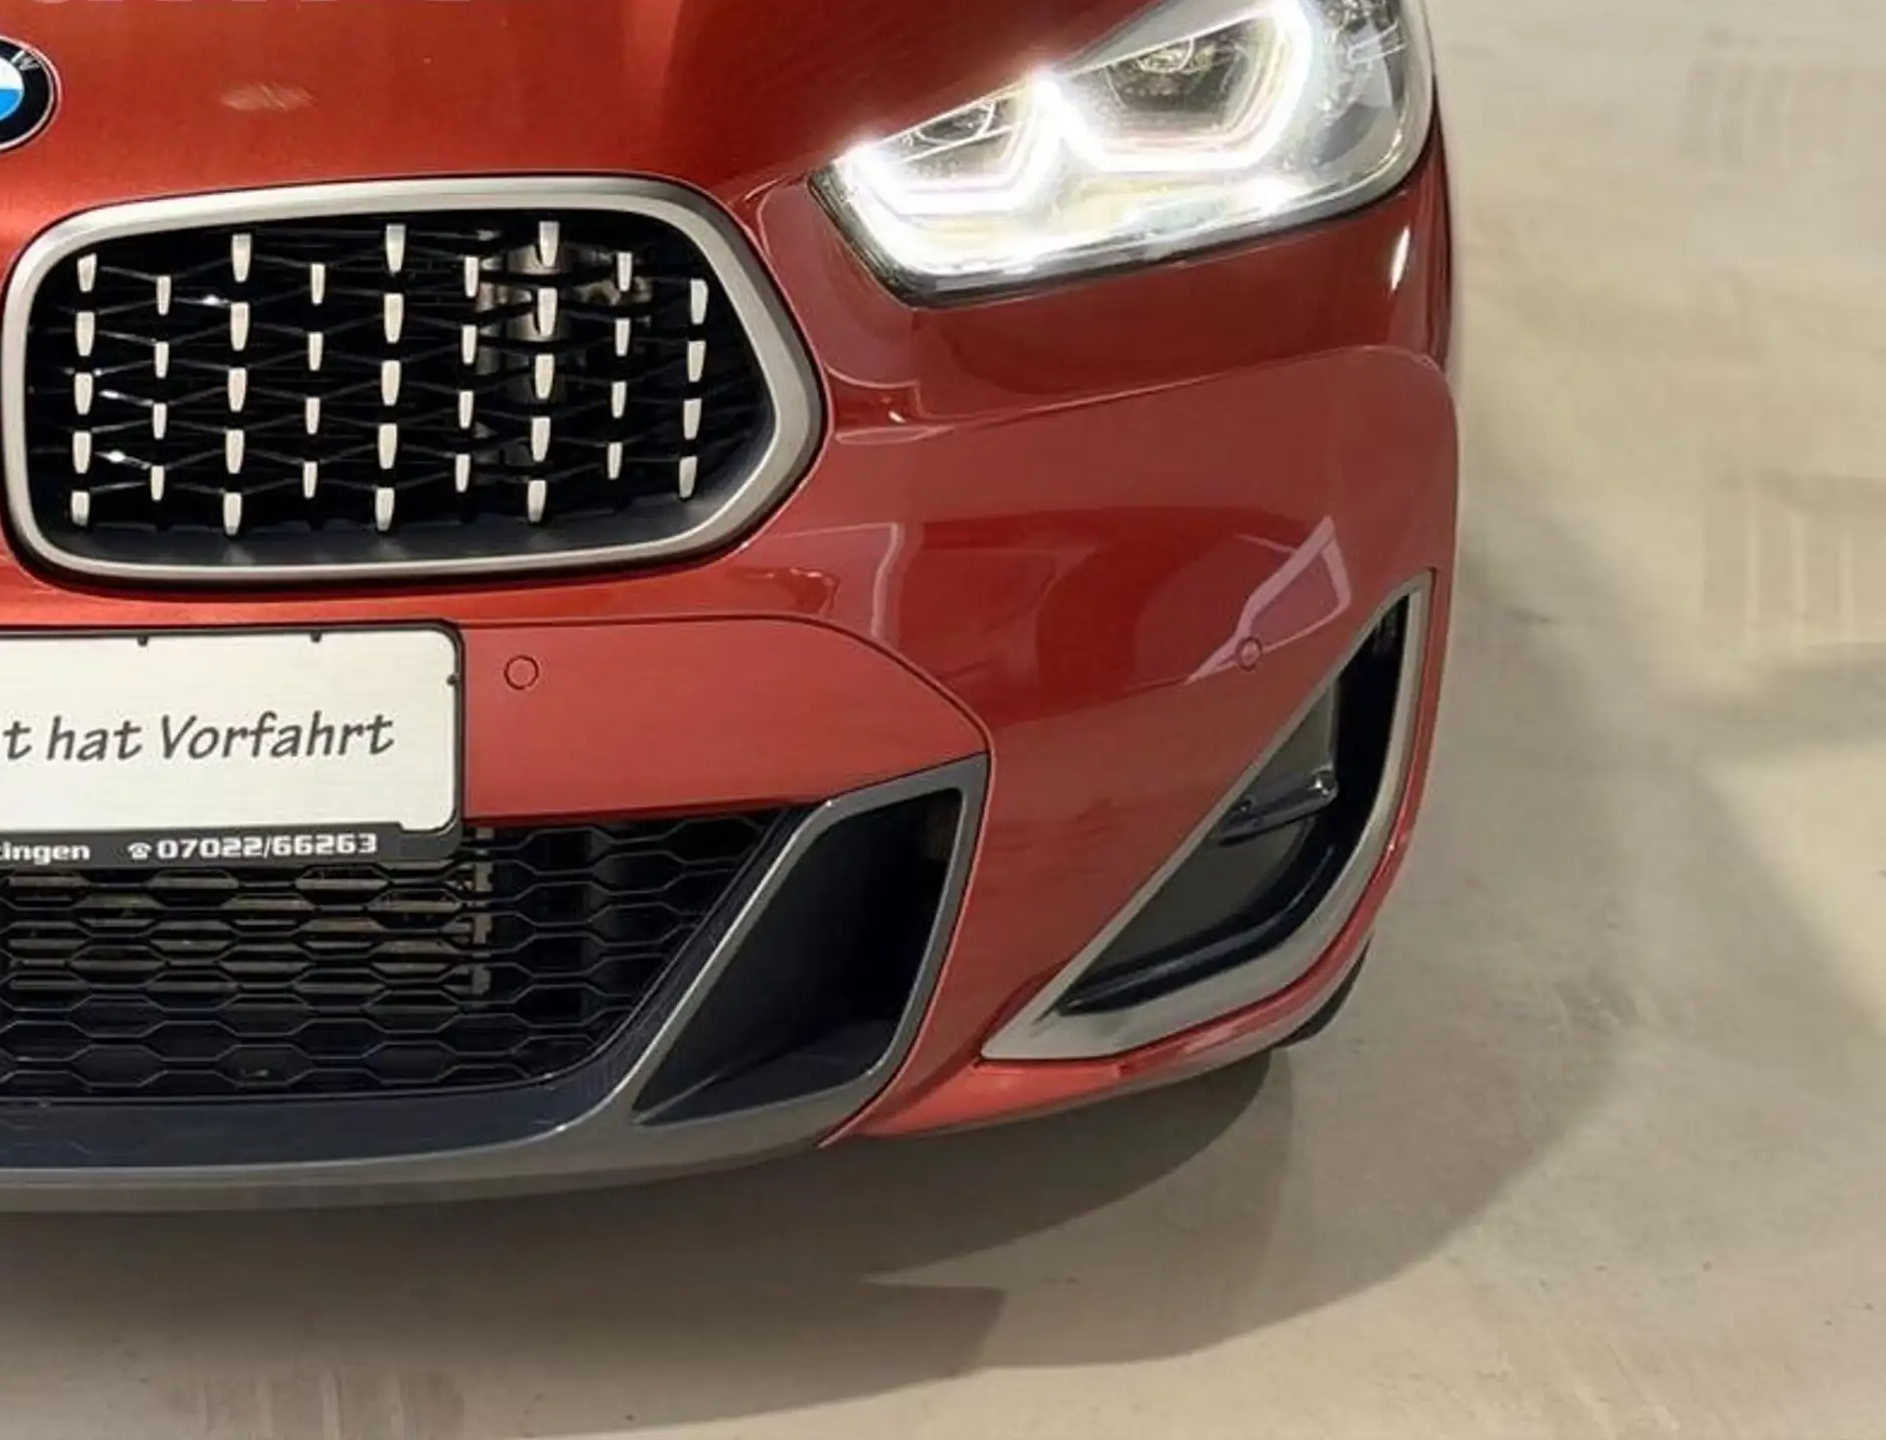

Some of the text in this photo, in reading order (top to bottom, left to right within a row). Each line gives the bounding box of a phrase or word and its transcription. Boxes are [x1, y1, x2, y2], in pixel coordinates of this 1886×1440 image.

[46, 714, 143, 761] hat
[160, 710, 395, 760] Vorfahrt
[157, 832, 378, 859] 07022/66263
